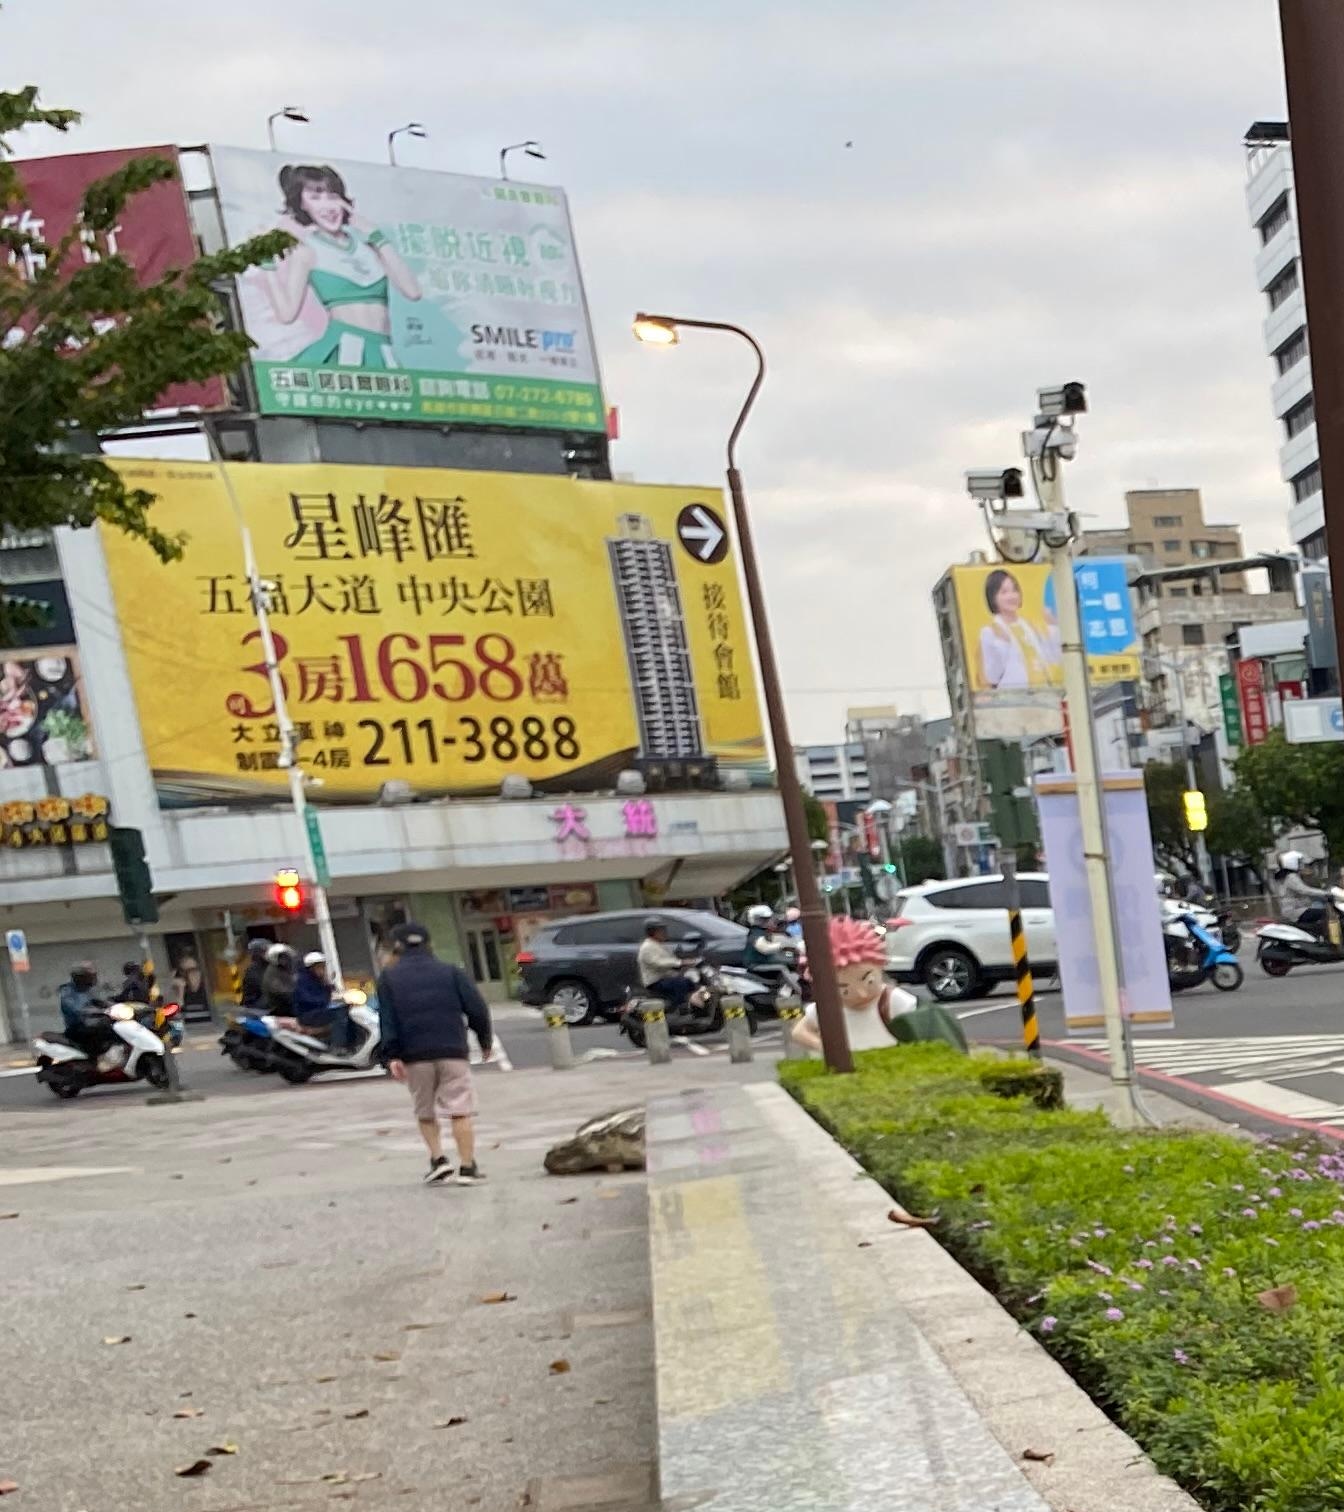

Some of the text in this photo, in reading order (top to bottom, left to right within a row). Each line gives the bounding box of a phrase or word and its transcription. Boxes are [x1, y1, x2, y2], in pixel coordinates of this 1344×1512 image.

[470, 323, 539, 349] SMILE
[284, 492, 478, 563] 星峰匯
[195, 574, 554, 618] 五福大道 中央公園
[357, 715, 580, 768] 211-3888
